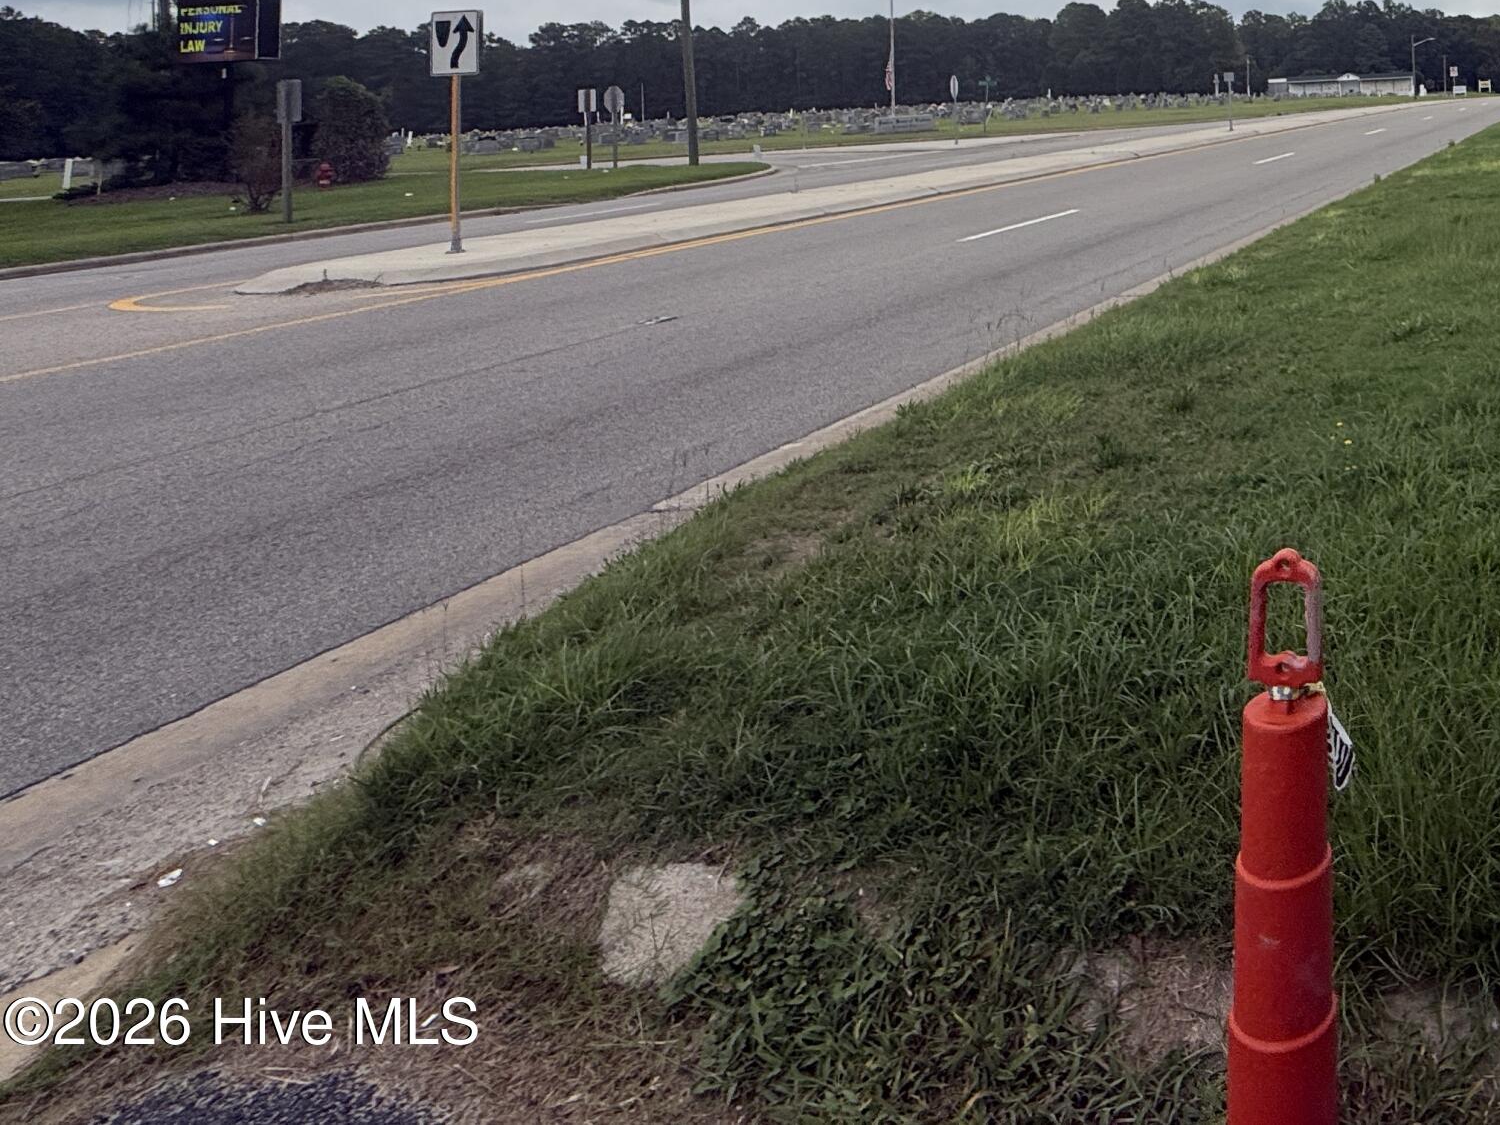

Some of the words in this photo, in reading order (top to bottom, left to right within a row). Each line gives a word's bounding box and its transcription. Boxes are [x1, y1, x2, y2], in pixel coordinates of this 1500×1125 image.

[180, 5, 242, 16] PERSONAL
[180, 20, 222, 34] INJURY
[180, 39, 205, 52] LAW
